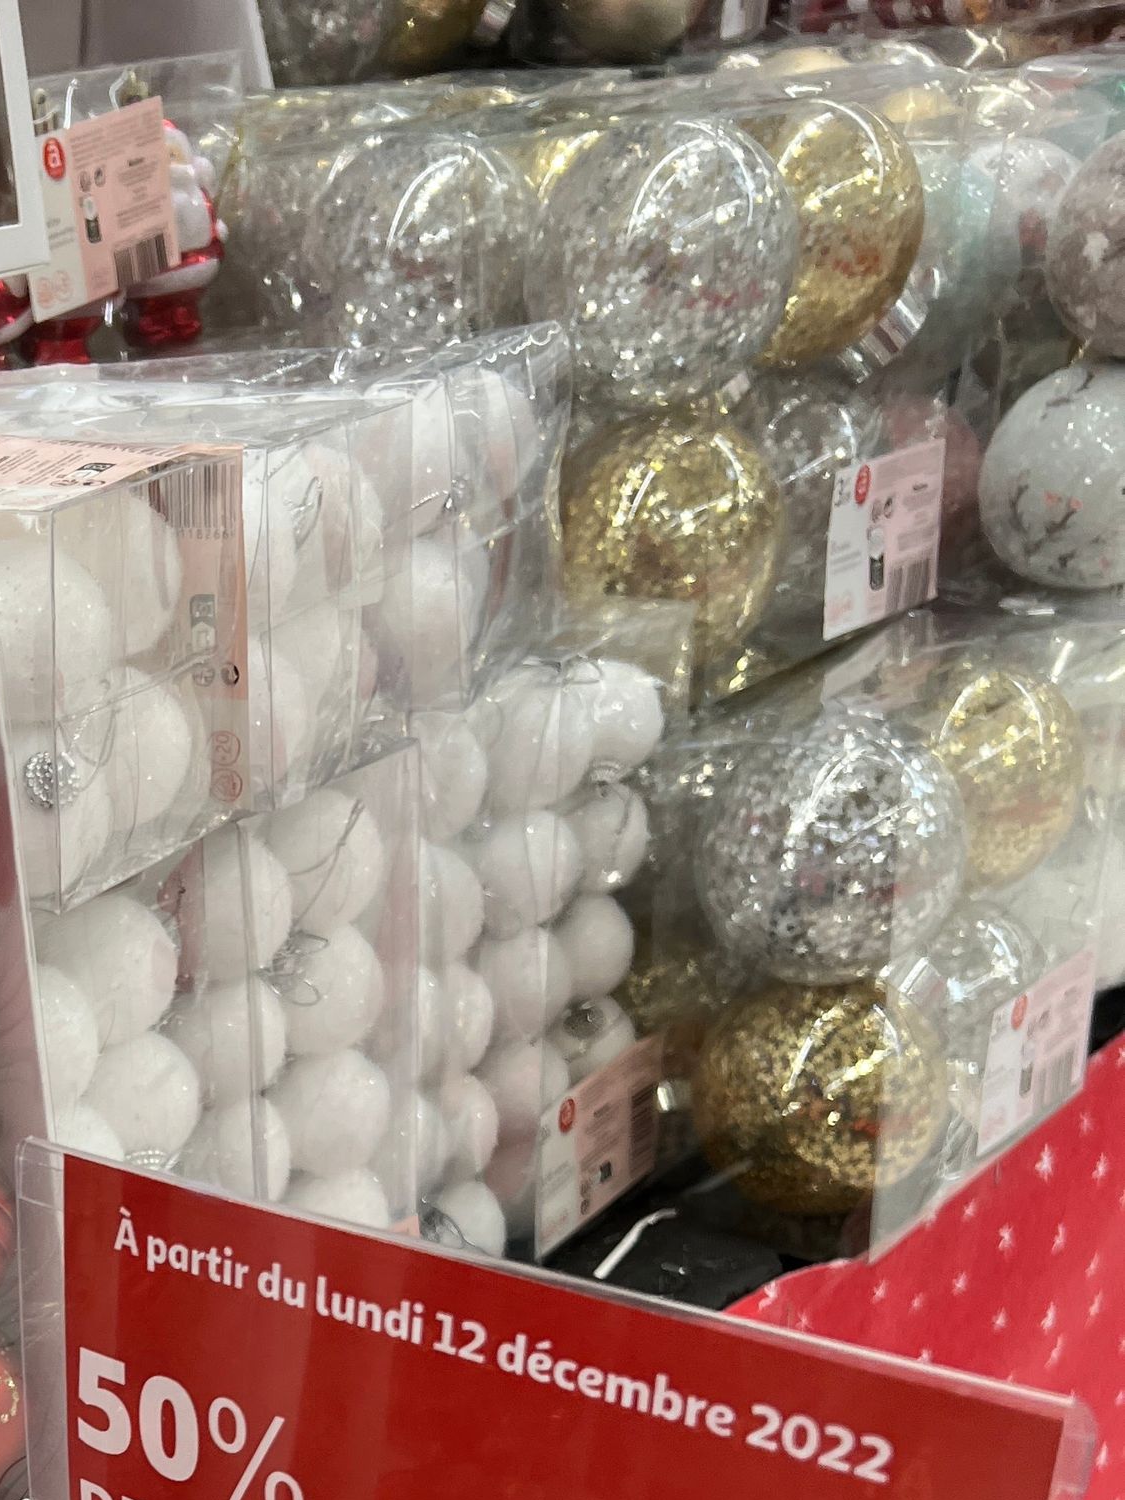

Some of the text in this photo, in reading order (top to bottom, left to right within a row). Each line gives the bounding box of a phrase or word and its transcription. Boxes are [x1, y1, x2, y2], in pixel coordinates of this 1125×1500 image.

[113, 1206, 894, 1484] À partir du lundi 12 décembre 2022
